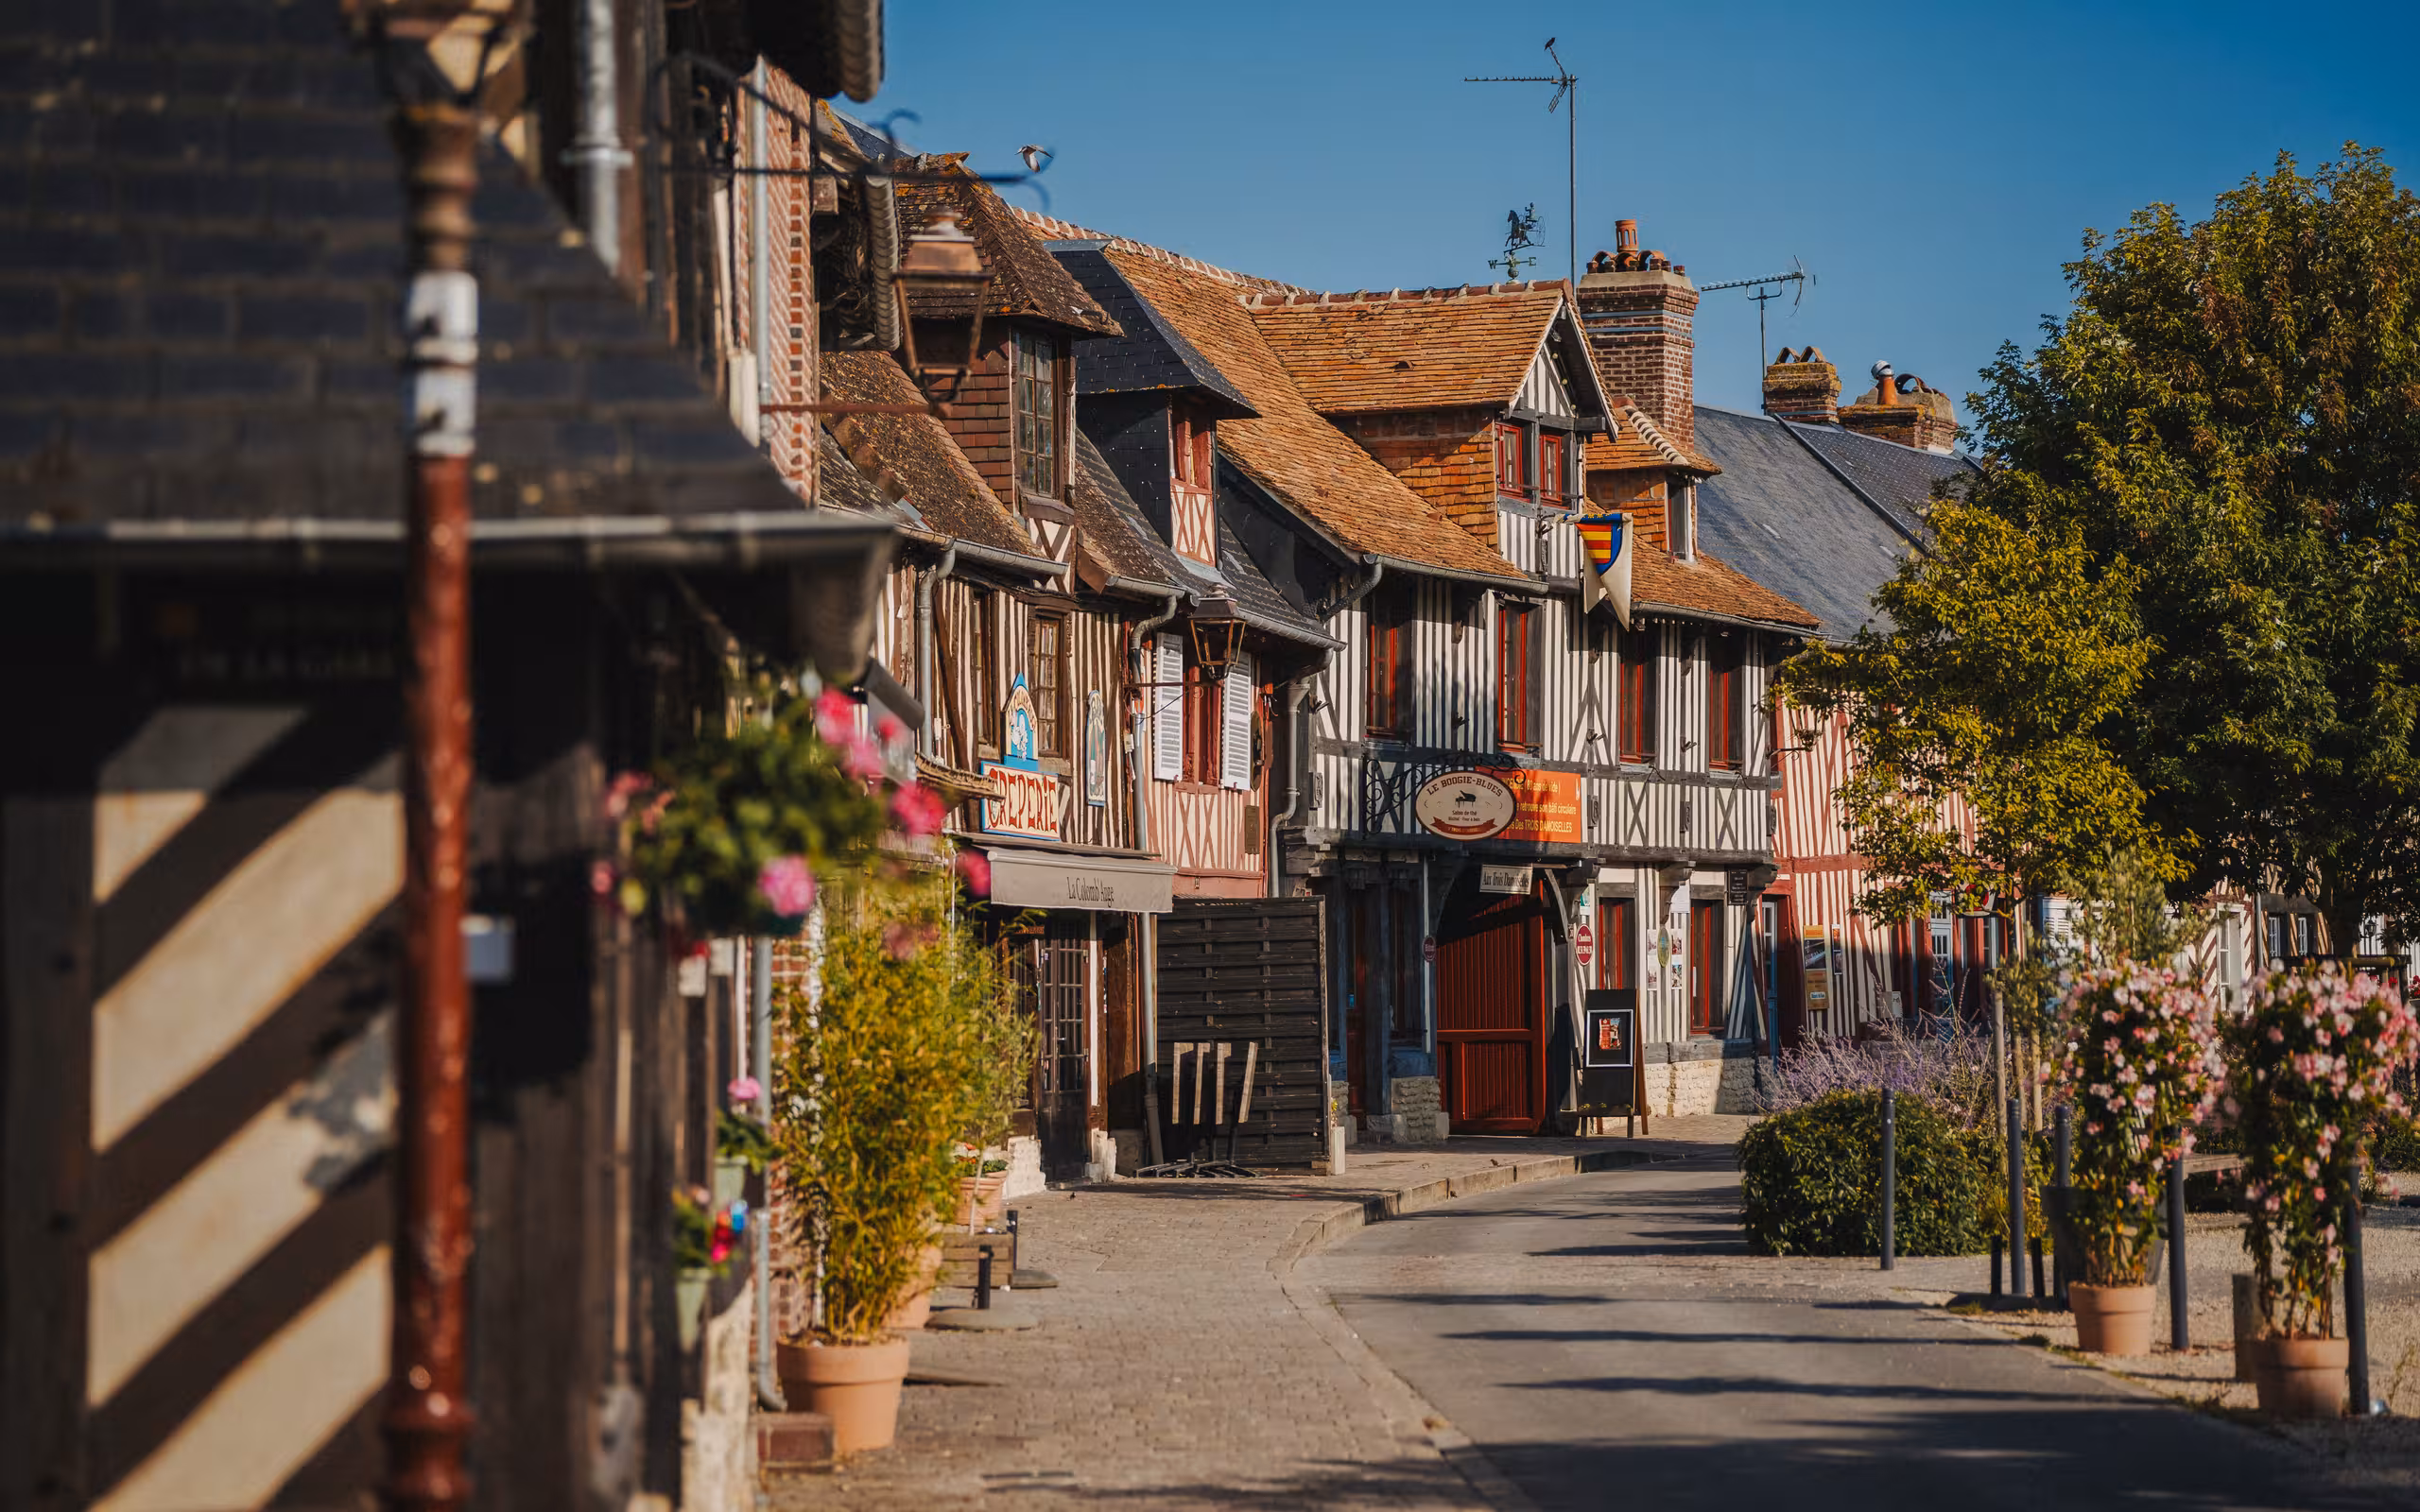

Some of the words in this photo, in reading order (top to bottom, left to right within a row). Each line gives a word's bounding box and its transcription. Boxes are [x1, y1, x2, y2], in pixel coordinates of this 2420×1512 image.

[1426, 783, 1440, 796] LE
[1441, 776, 1503, 798] BOOGIE-BLUES
[1533, 782, 1542, 791] ans
[1539, 804, 1547, 814] son
[1557, 803, 1577, 815] circulaire
[1515, 819, 1524, 830] Des
[1525, 819, 1539, 832] TROIS
[1539, 820, 1573, 833] DAMOISELLES
[1482, 871, 1492, 885] Aux
[1493, 871, 1503, 885] Trois
[1504, 872, 1530, 886] Damoiselles
[1066, 876, 1076, 900] La
